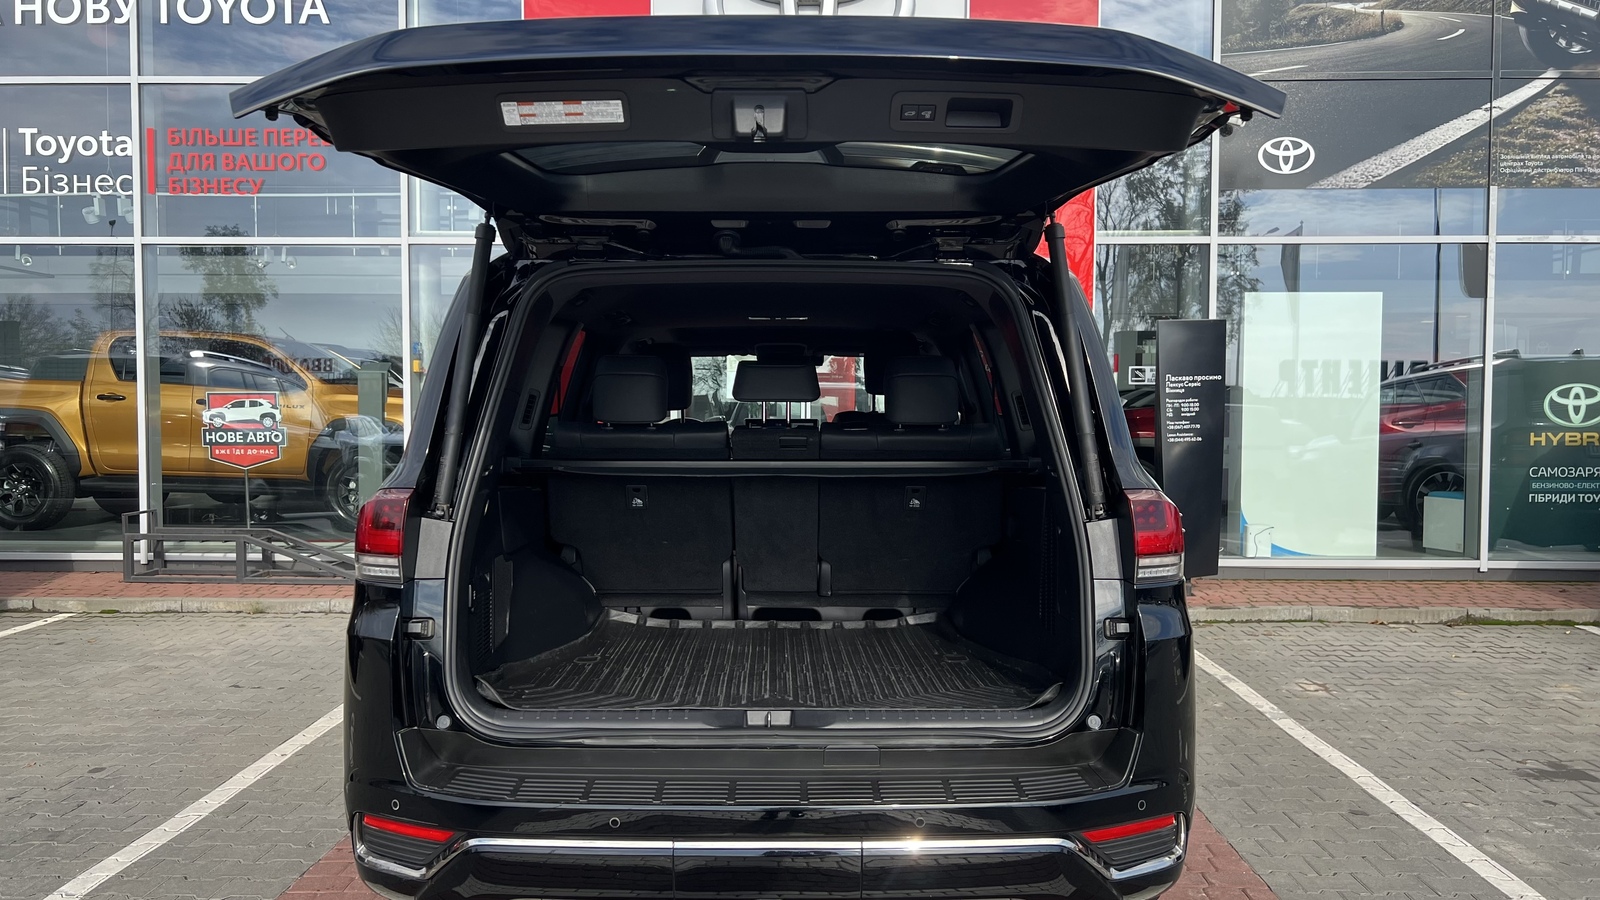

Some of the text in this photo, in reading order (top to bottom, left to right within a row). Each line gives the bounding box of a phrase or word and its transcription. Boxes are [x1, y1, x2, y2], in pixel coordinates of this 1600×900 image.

[15, 0, 134, 24] НОВУ
[160, 0, 331, 24] TOYOTA
[18, 127, 132, 164] Toyota
[167, 127, 333, 147] БІЛЬШЕ ПЕРЕ
[166, 152, 326, 174] ДЛЯ ВАШОГО
[22, 166, 132, 195] Бізнес
[168, 177, 264, 195] БІЗНЕСУ
[205, 431, 283, 443] НОВЕ АВТО
[1529, 432, 1600, 446] HYBR
[232, 447, 245, 456] ЇДЕ
[247, 448, 258, 456] ДО
[1529, 466, 1600, 478] САМОЗАРЯ
[1528, 493, 1600, 504] ГІБРИДИ TOY
